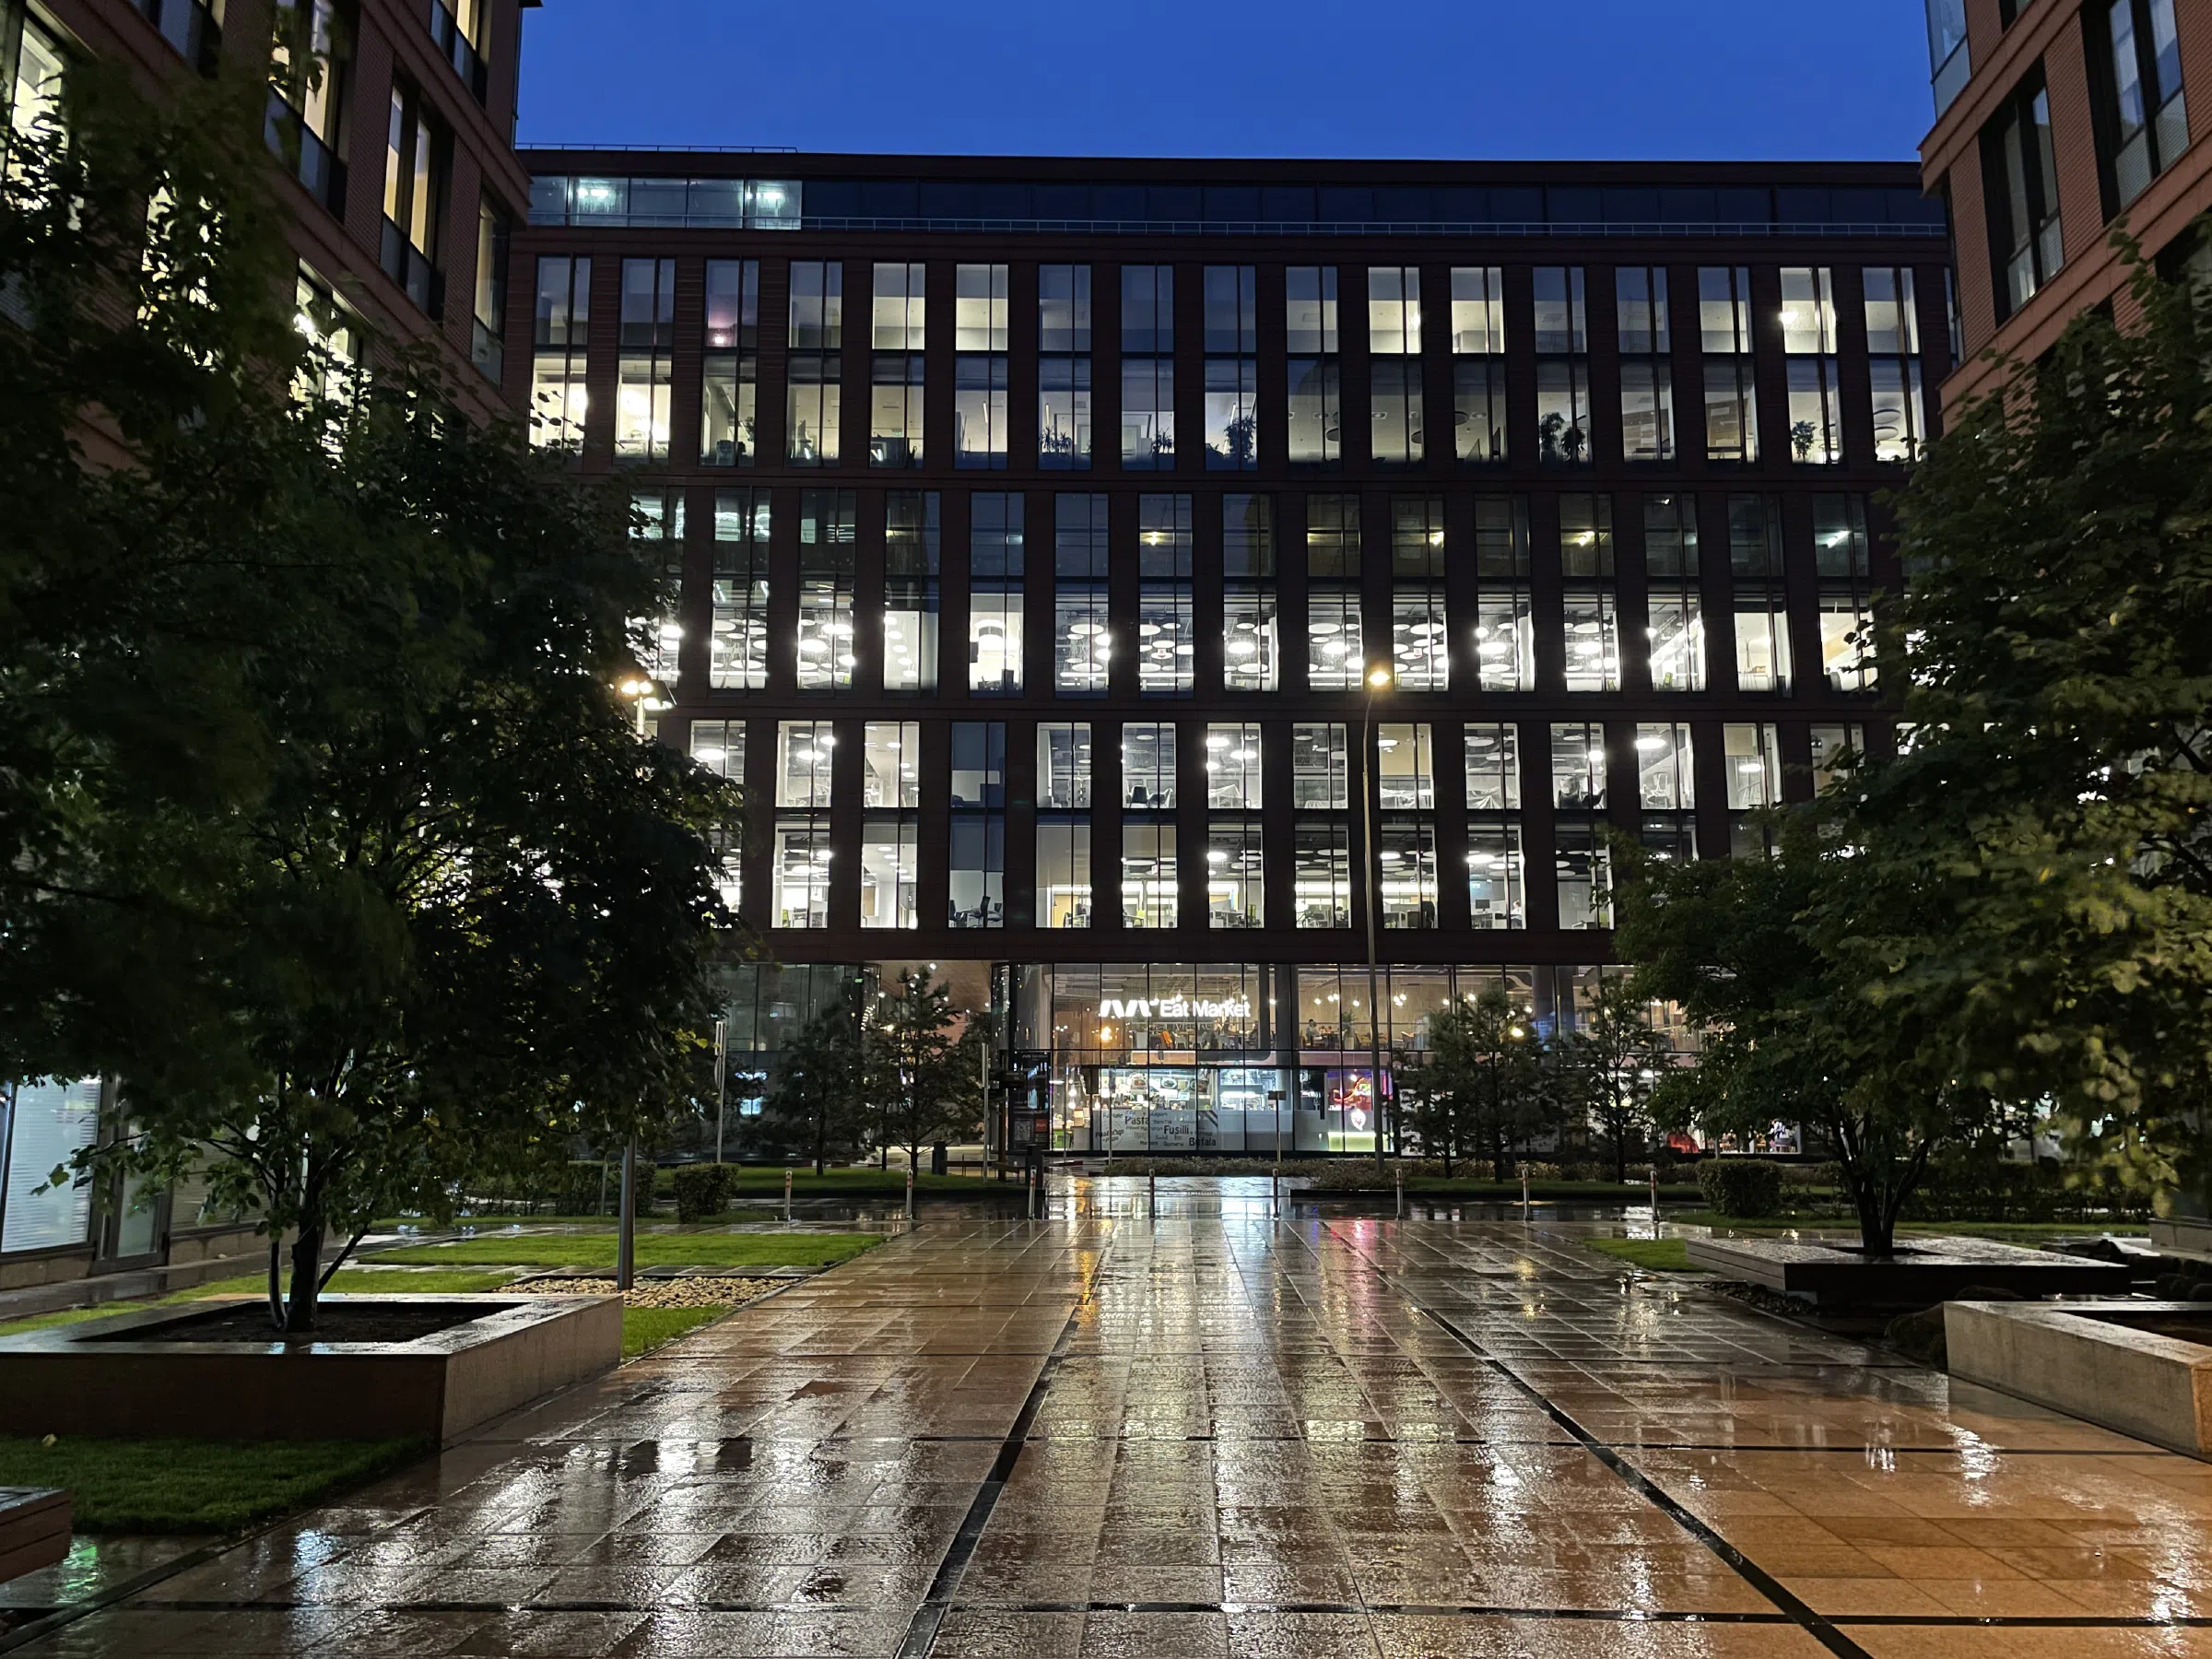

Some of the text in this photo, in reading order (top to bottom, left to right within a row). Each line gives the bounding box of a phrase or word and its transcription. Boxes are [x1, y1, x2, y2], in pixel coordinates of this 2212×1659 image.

[1159, 1000, 1189, 1018] Eat
[1193, 1000, 1251, 1018] Market
[1124, 1115, 1149, 1125] Pasta
